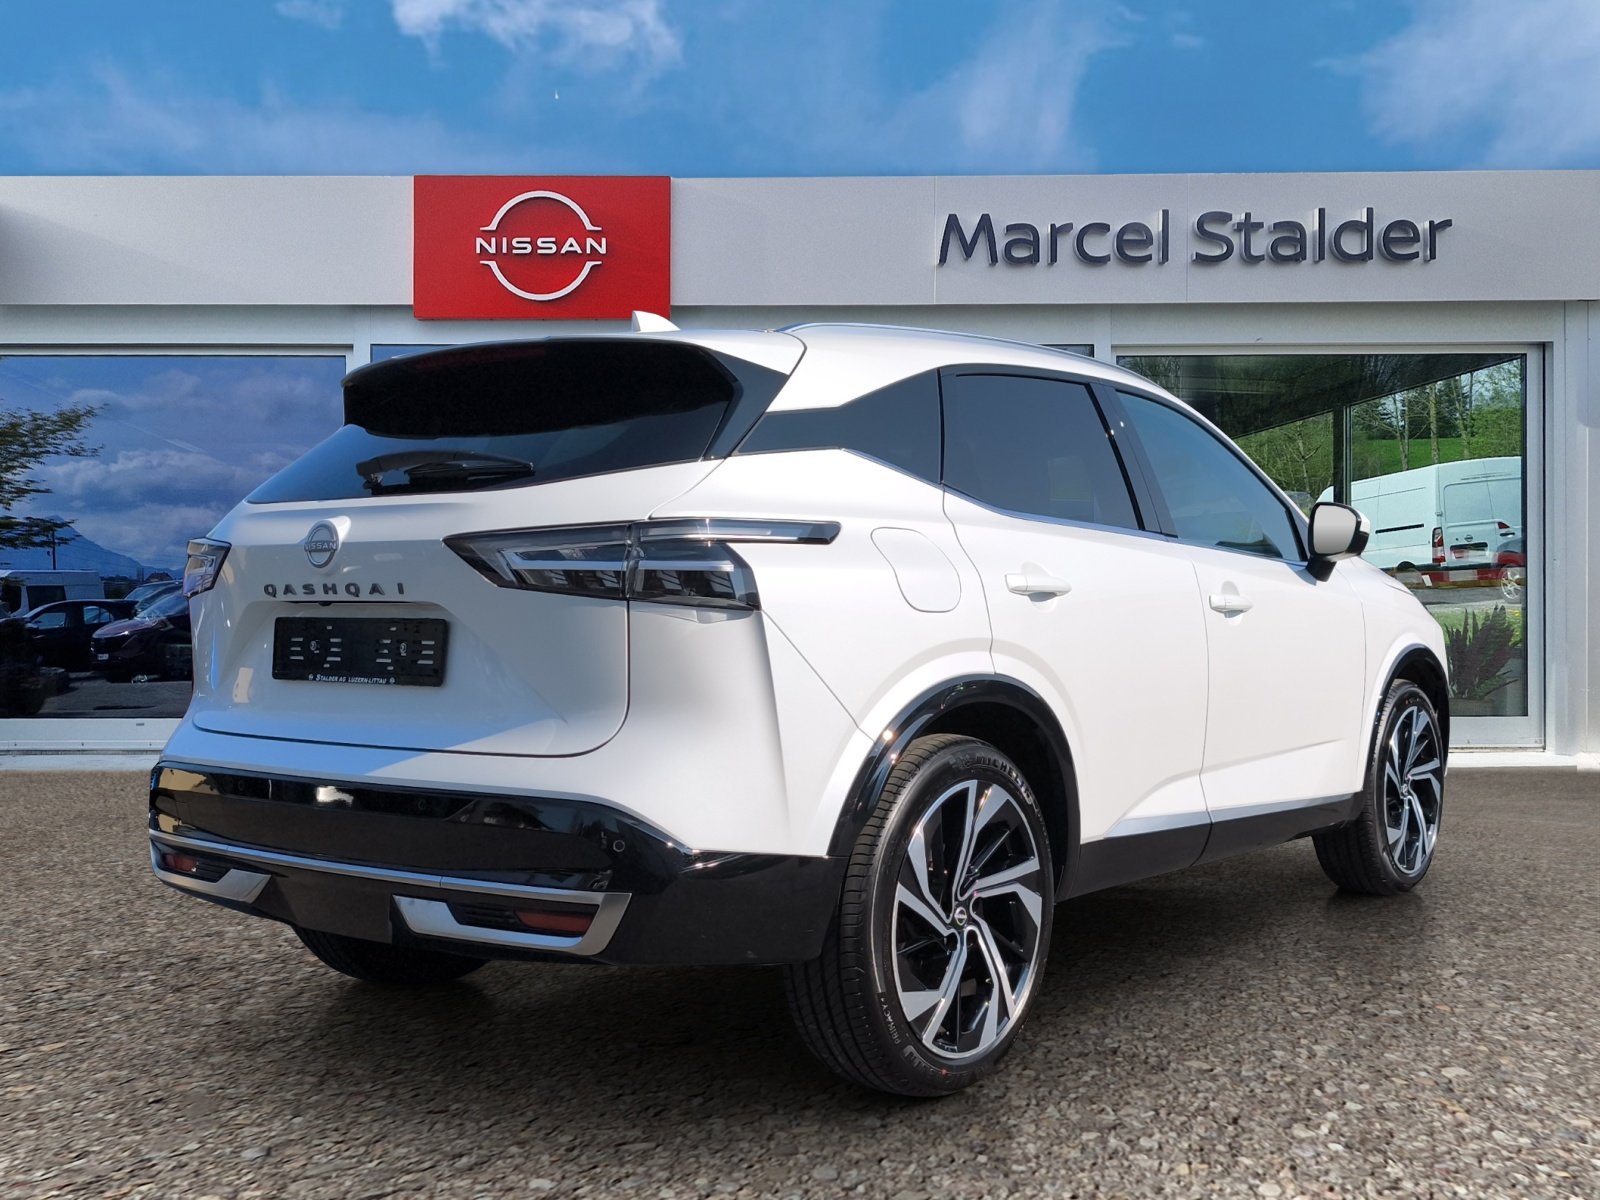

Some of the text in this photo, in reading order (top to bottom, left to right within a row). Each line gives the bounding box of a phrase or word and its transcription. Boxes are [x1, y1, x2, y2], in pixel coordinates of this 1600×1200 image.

[938, 206, 1453, 266] Marcel Stalder
[475, 237, 607, 255] NISSAN
[263, 582, 405, 598] QASHQAI
